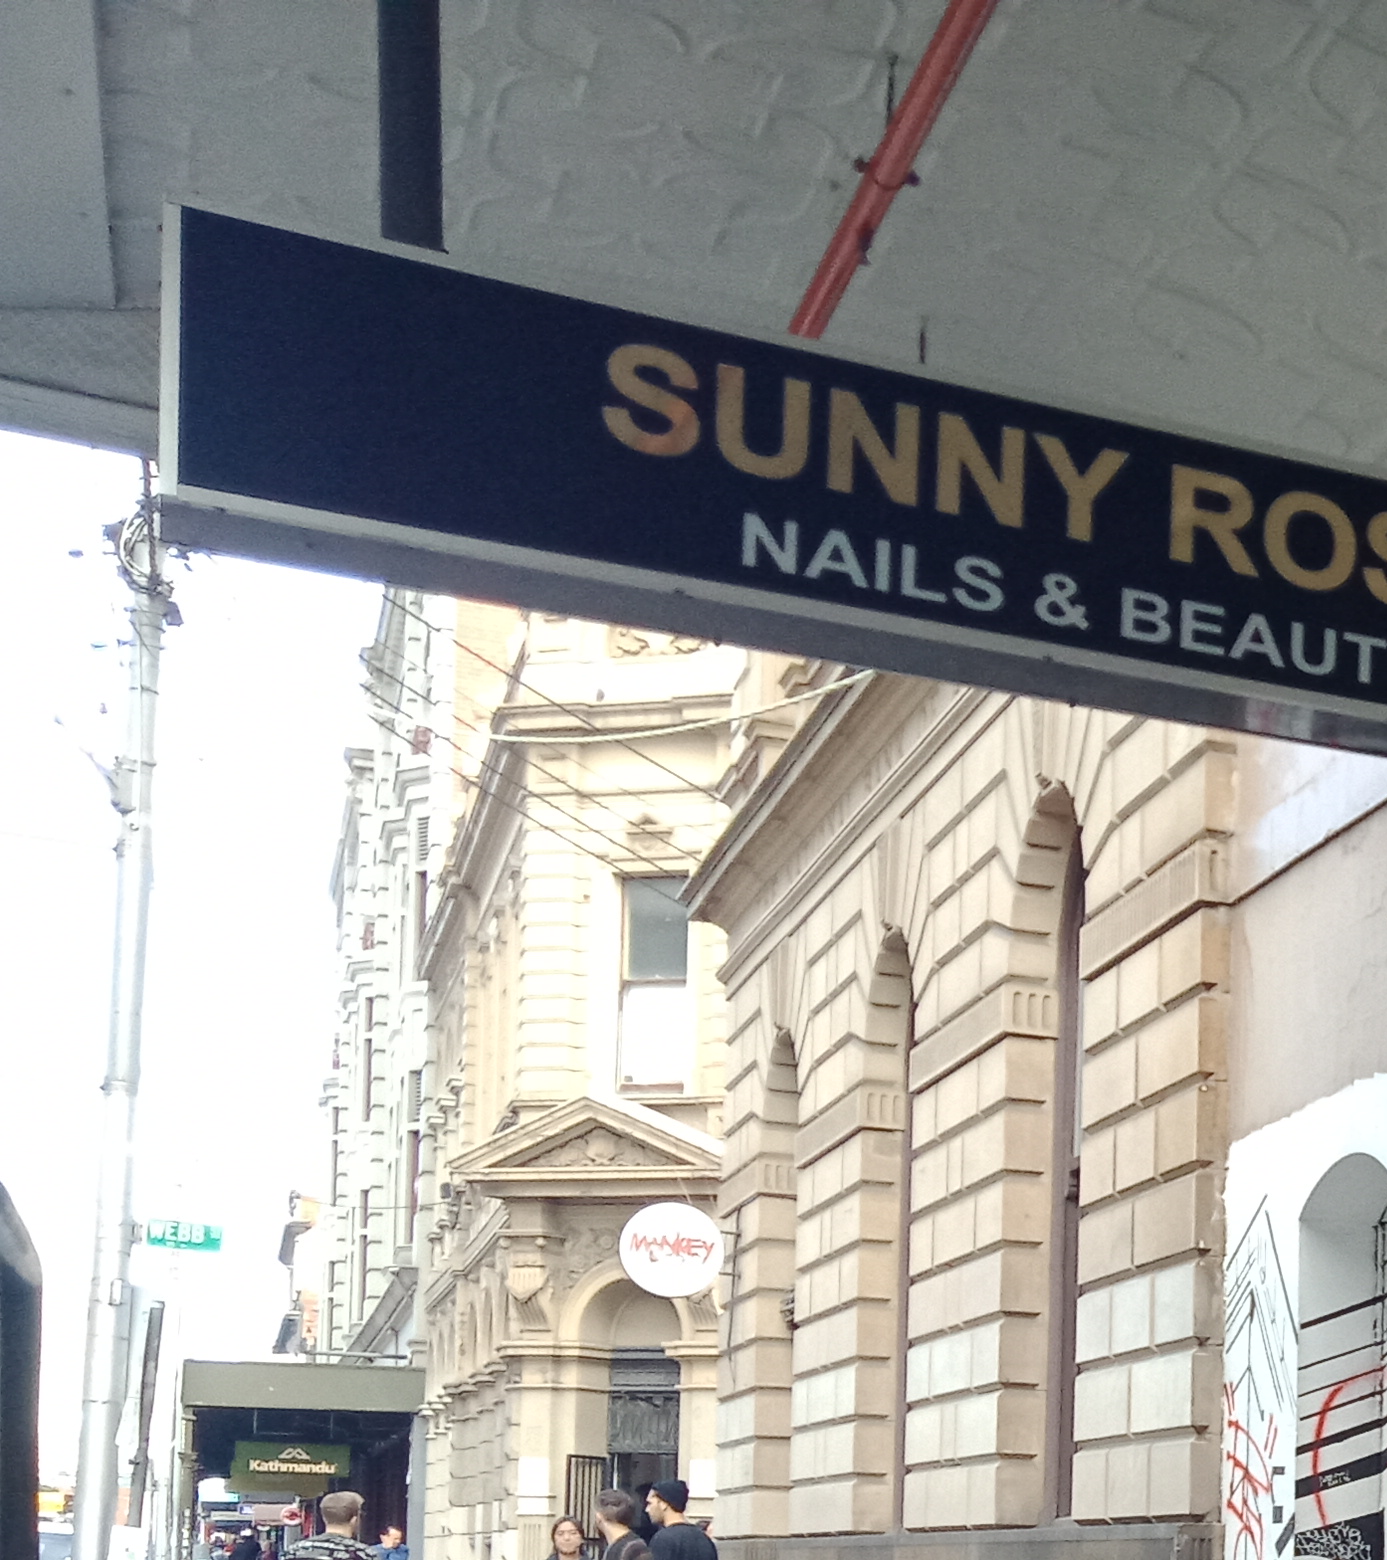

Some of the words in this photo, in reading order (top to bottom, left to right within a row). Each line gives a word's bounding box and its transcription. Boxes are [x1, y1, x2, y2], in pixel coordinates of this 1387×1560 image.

[602, 343, 1129, 542] SUNNY
[742, 511, 1005, 612] NAILS
[1033, 572, 1091, 631] &
[149, 1219, 205, 1245] WEBB
[249, 1458, 336, 1475] Kathmandu
